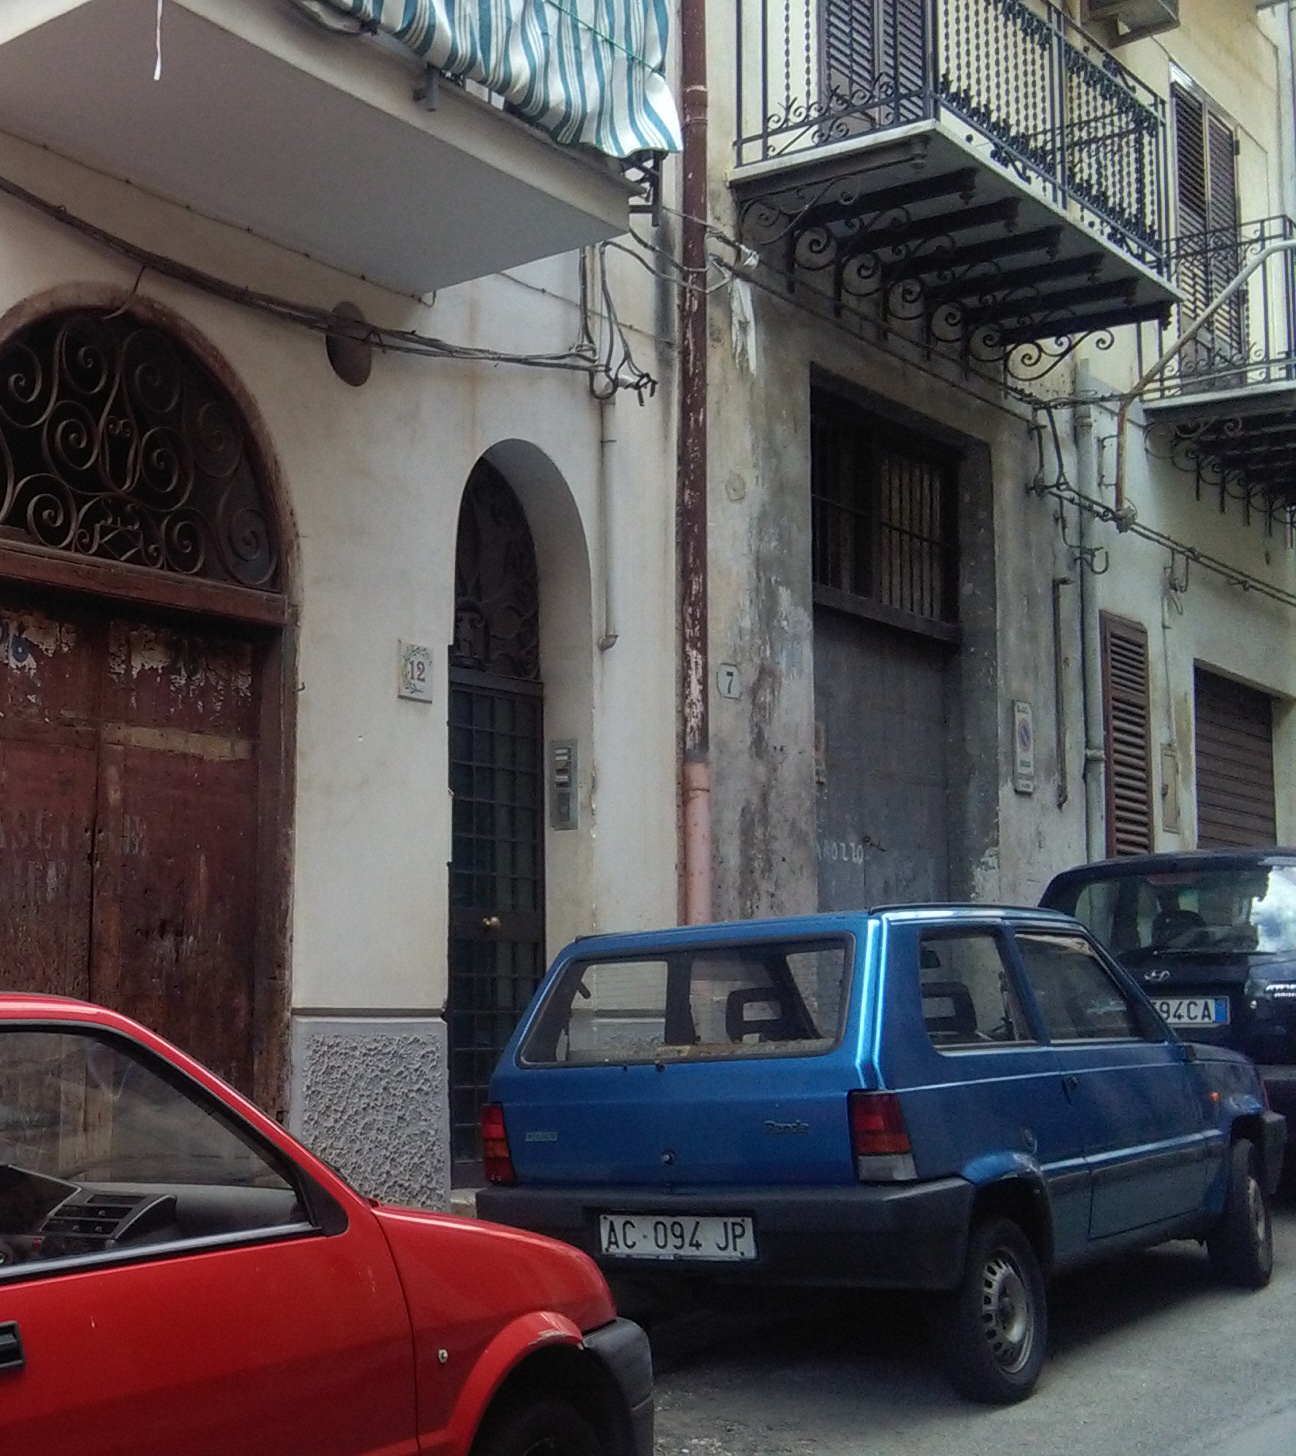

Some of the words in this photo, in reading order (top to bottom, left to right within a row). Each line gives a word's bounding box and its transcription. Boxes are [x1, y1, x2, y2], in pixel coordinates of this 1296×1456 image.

[408, 659, 426, 683] 12
[725, 670, 735, 695] 7
[1151, 1000, 1213, 1021] 94CA
[652, 1220, 703, 1252] 094
[715, 1221, 746, 1253] JP
